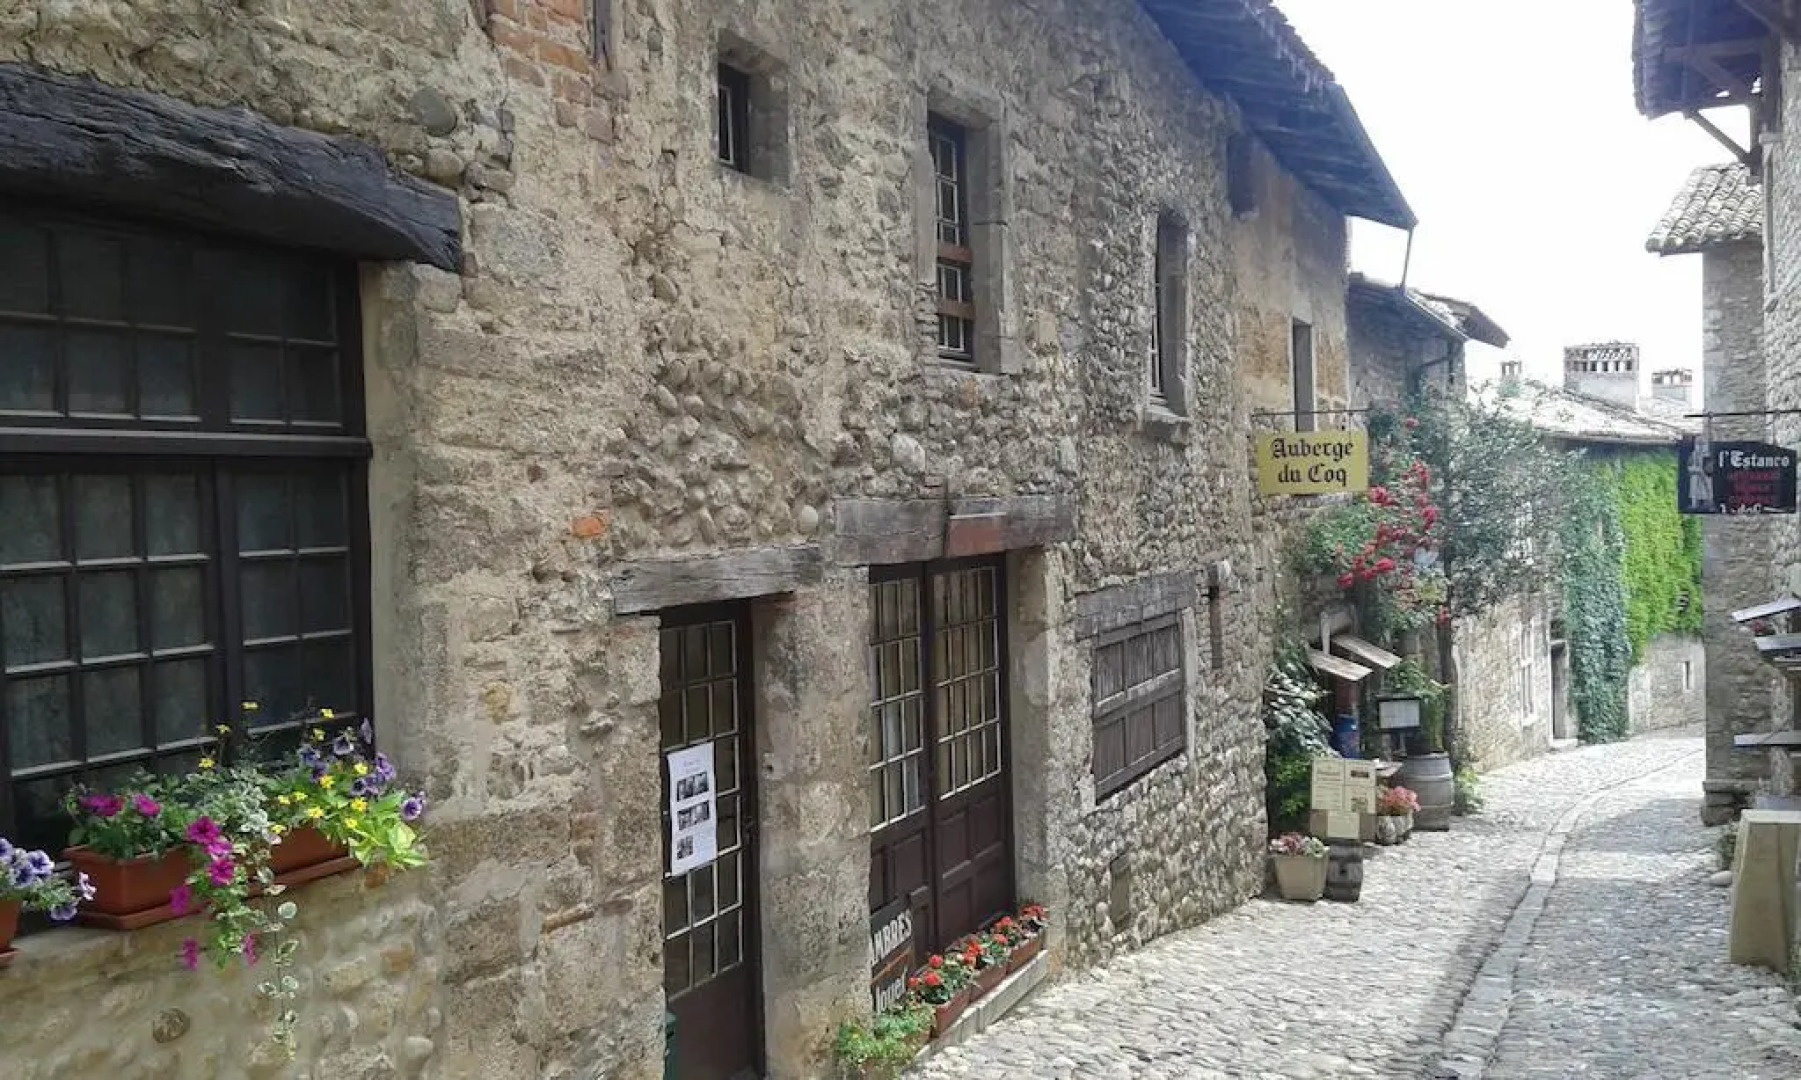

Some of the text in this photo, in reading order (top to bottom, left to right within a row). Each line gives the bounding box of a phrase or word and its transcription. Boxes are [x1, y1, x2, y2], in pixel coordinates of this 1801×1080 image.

[1270, 438, 1353, 461] Auberge
[1278, 463, 1346, 487] du Coq
